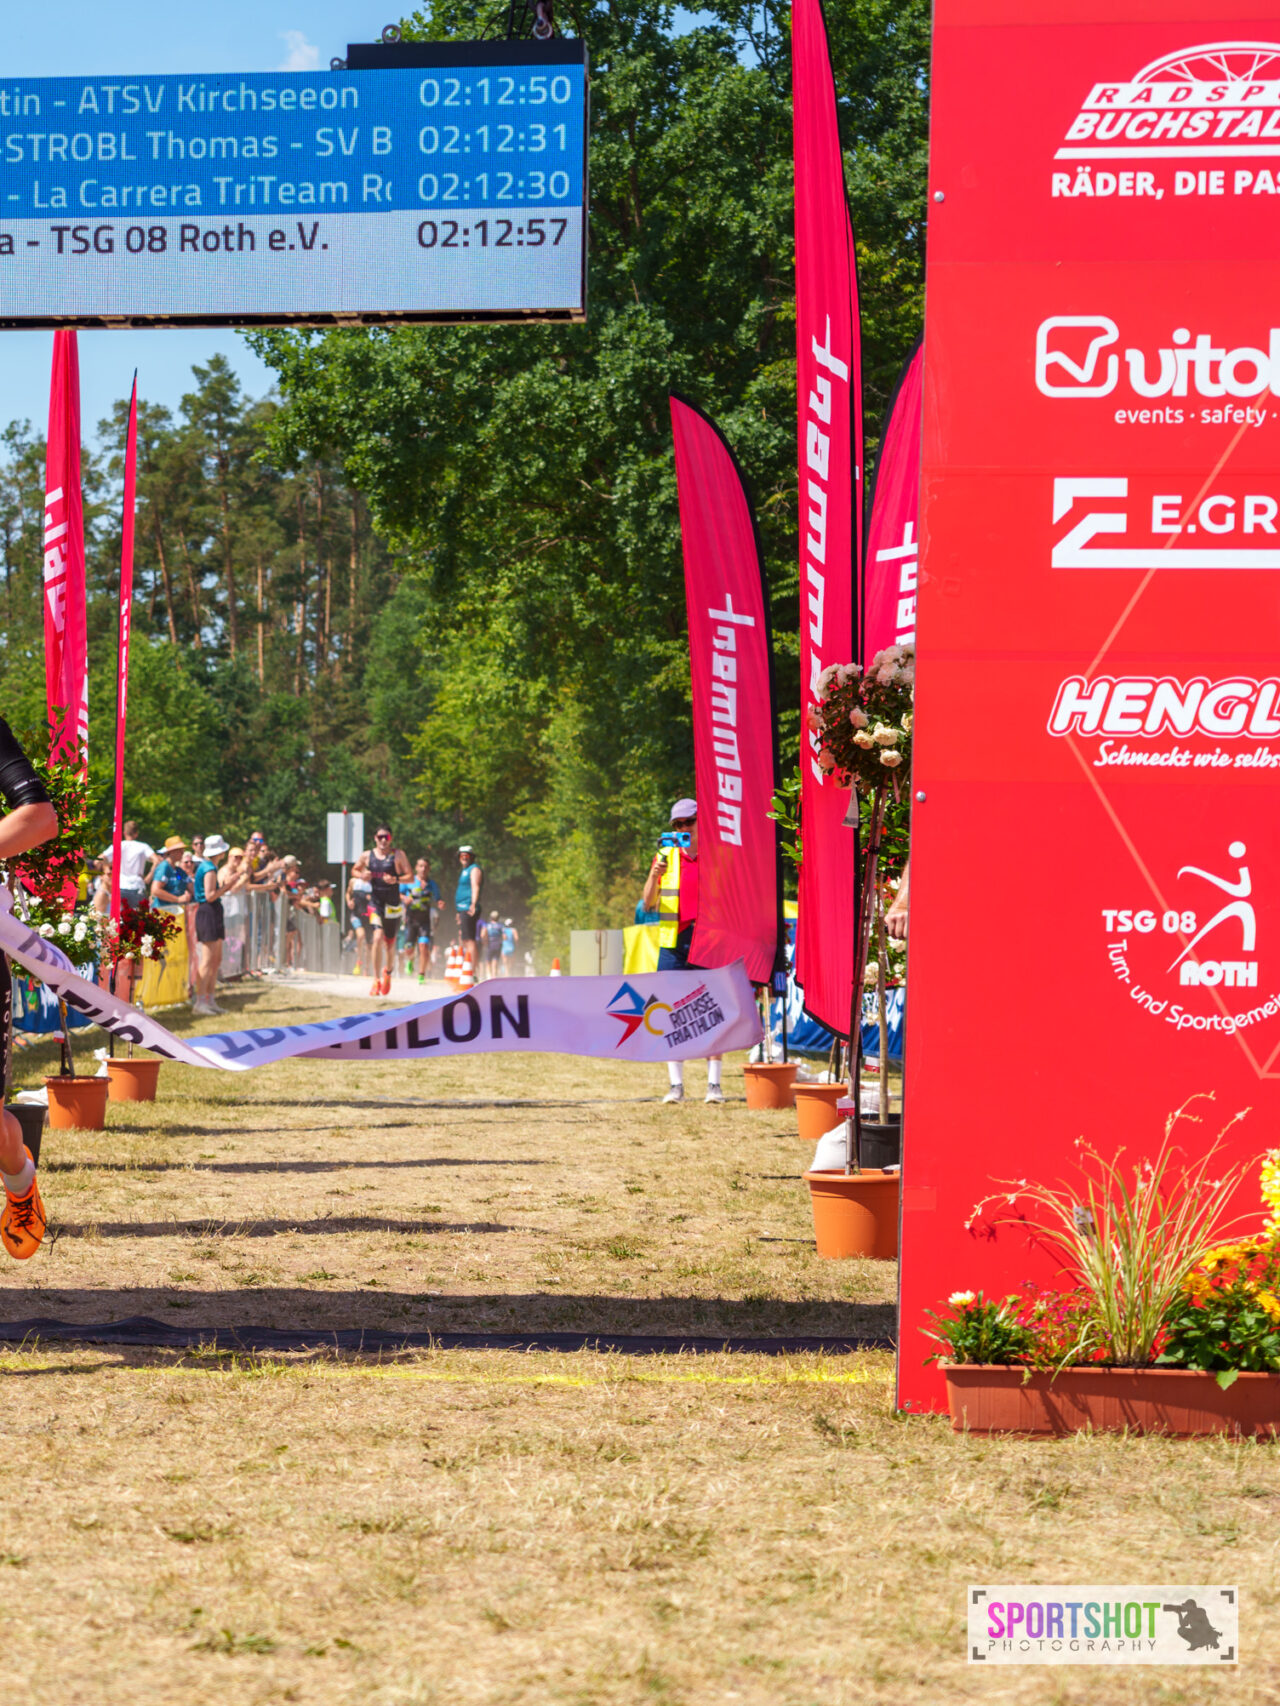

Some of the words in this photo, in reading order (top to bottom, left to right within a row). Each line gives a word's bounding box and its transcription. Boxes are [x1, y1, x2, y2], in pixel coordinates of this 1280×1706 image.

[78, 85, 165, 114] ATSV
[178, 82, 360, 113] Kirchseeon
[419, 76, 572, 107] 02:12:50
[1094, 84, 1280, 105] RADSP
[146, 130, 278, 160] Thomas
[315, 127, 359, 157] SV
[372, 126, 393, 155] B
[418, 123, 568, 154] 02:12:31
[34, 180, 68, 209] La
[79, 179, 202, 207] Carrera
[213, 175, 348, 205] TriTeam
[417, 171, 571, 201] 02:12:30
[1052, 166, 1165, 200] RÄDER,
[1174, 171, 1225, 195] DIE
[1234, 170, 1280, 195] PA
[50, 225, 115, 254] TSG
[125, 225, 168, 254] 08
[180, 222, 256, 252] Roth
[268, 221, 329, 251] e.V.
[417, 218, 568, 249] 02:12:57
[1114, 405, 1184, 424] events
[1200, 404, 1267, 428] safety
[1094, 740, 1193, 767] Schmeckt
[1193, 747, 1233, 767] wie
[1233, 746, 1280, 768] selbs
[1102, 910, 1157, 933] TSG
[1162, 911, 1197, 933] 08
[1107, 938, 1130, 984] Turn-
[1130, 985, 1169, 1014] und
[1165, 994, 1280, 1035] Sportgemei
[1179, 960, 1259, 987] ROTH
[669, 991, 719, 1030] ROTHSEE
